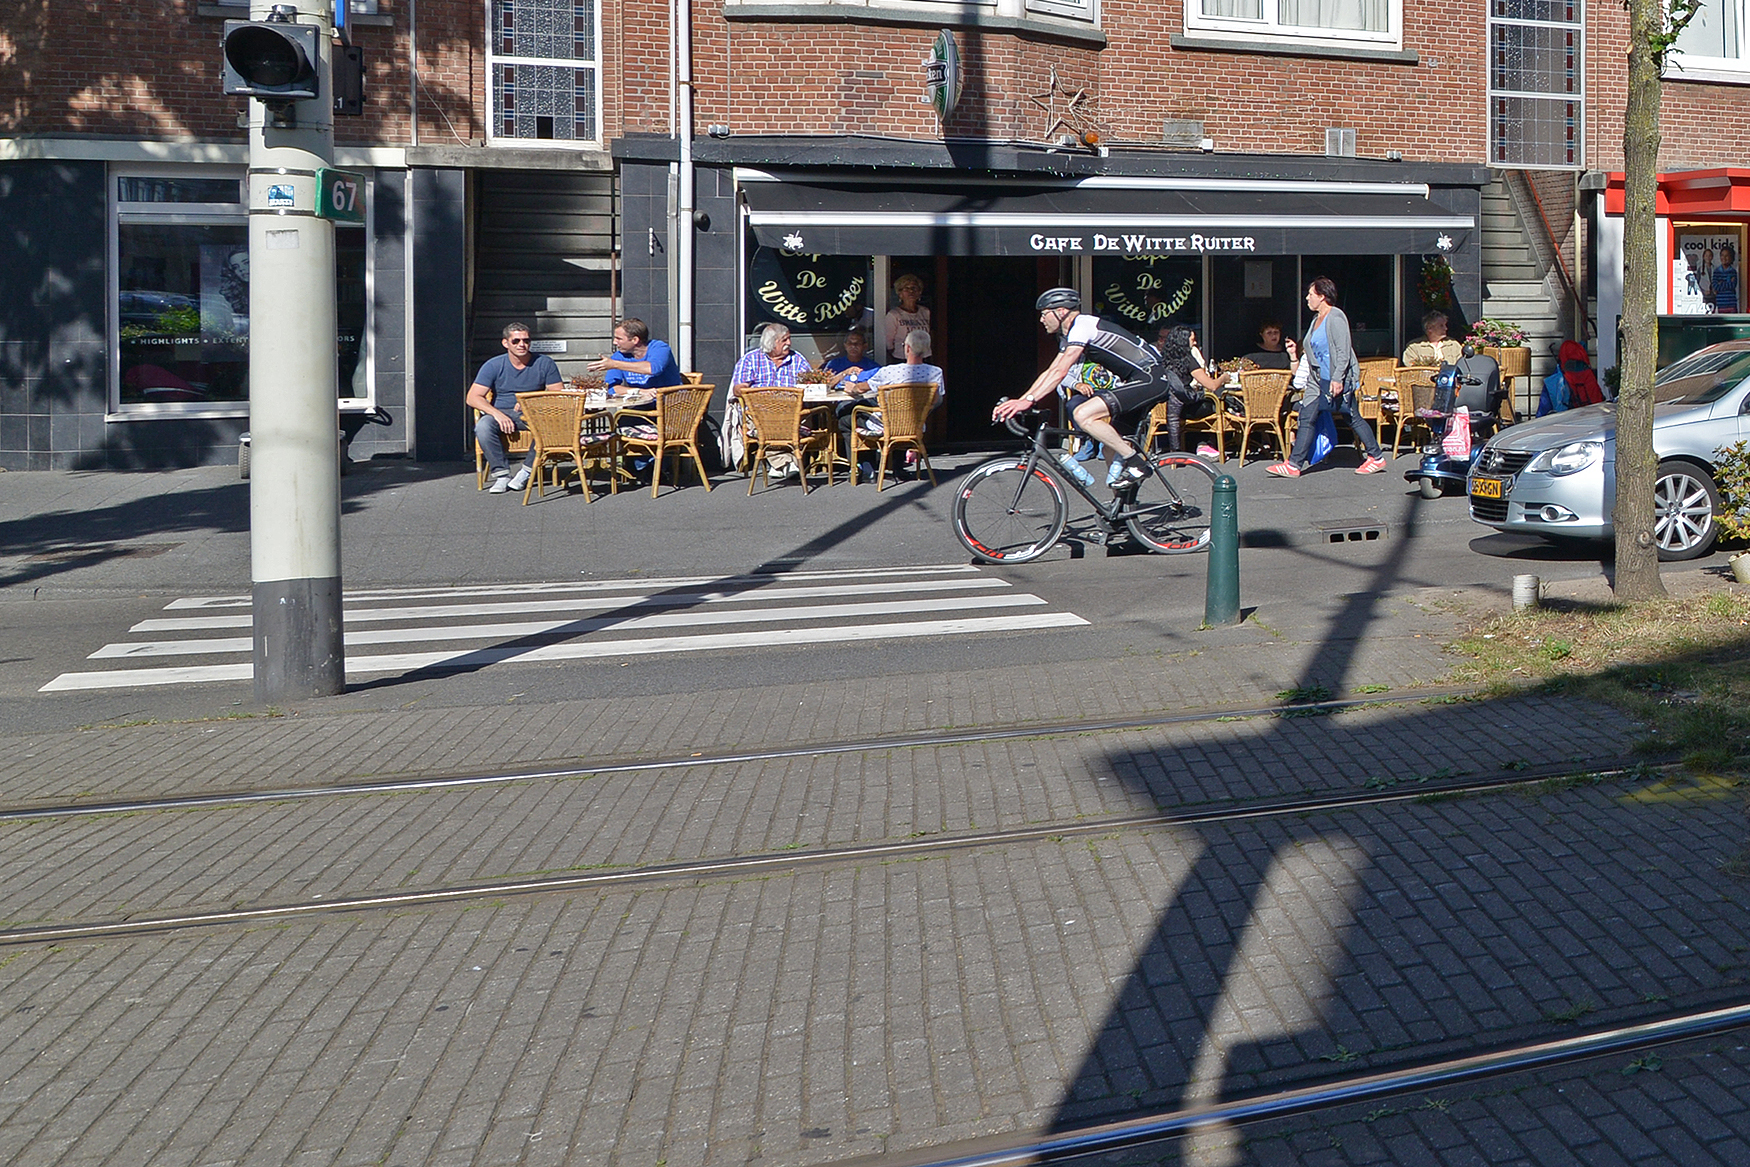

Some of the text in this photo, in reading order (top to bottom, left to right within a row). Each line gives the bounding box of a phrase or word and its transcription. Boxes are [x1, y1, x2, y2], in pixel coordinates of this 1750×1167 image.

[332, 180, 358, 212] 67
[1684, 238, 1735, 251] cool kids
[796, 270, 827, 289] De
[1136, 272, 1162, 290] De
[757, 276, 865, 324] Witte Ruiter
[1104, 277, 1195, 322] Witte Ruiter
[140, 337, 200, 345] HIGHLIGHTS
